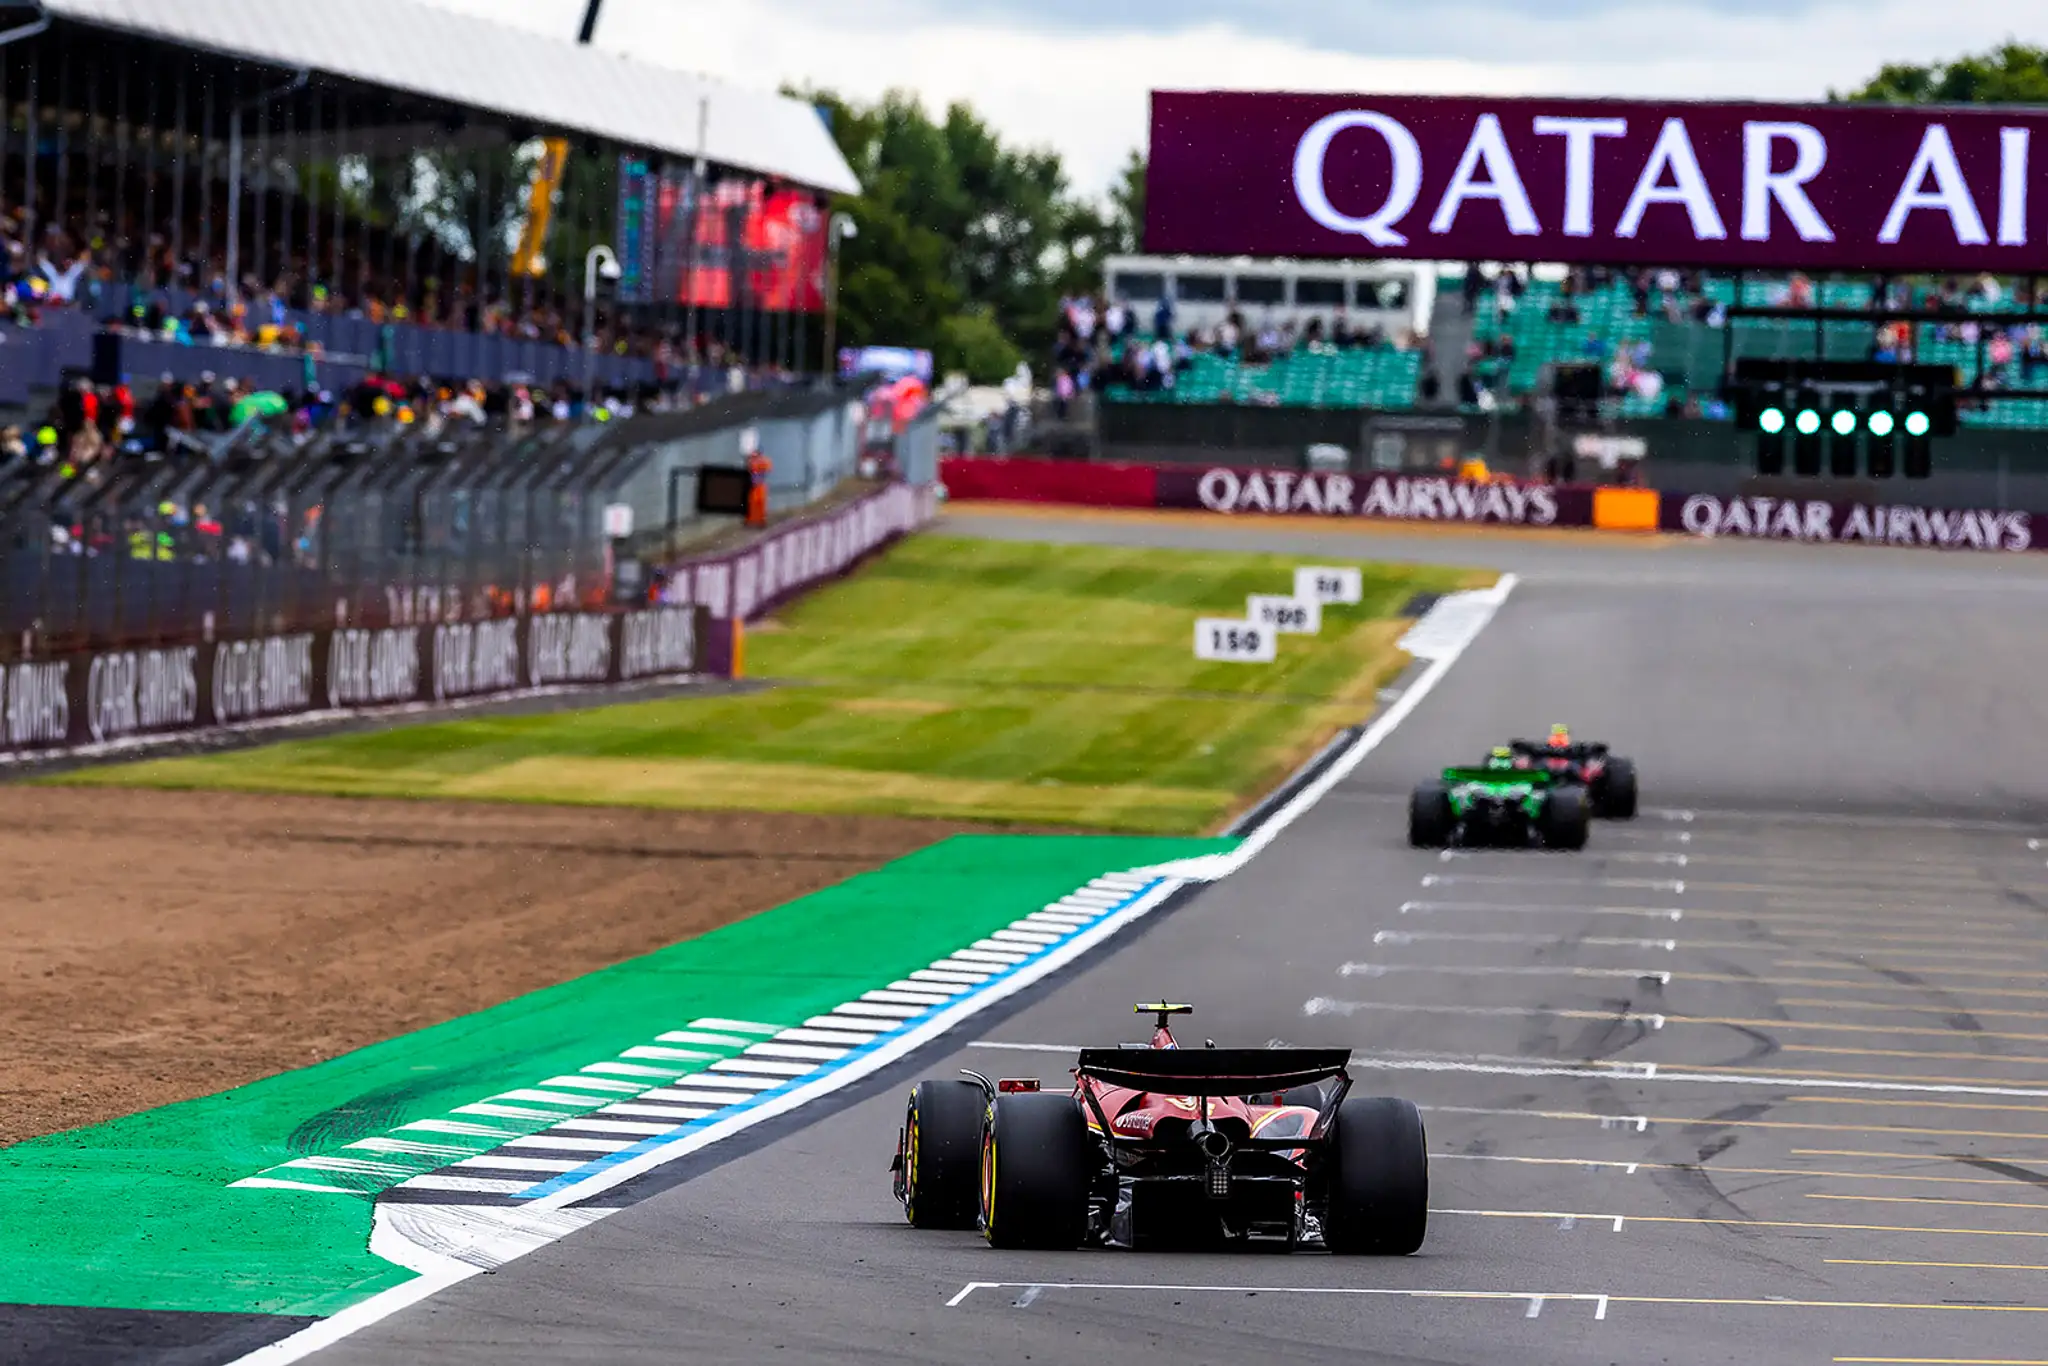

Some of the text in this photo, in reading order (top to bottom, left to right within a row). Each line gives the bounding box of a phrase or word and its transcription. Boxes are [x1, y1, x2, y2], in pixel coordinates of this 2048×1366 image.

[1292, 110, 2030, 246] QATAR AI
[1198, 468, 1559, 525] QATAR AIRWAYS
[1681, 494, 2031, 551] QATAR AIRWAYS
[1213, 629, 1261, 652] 150
